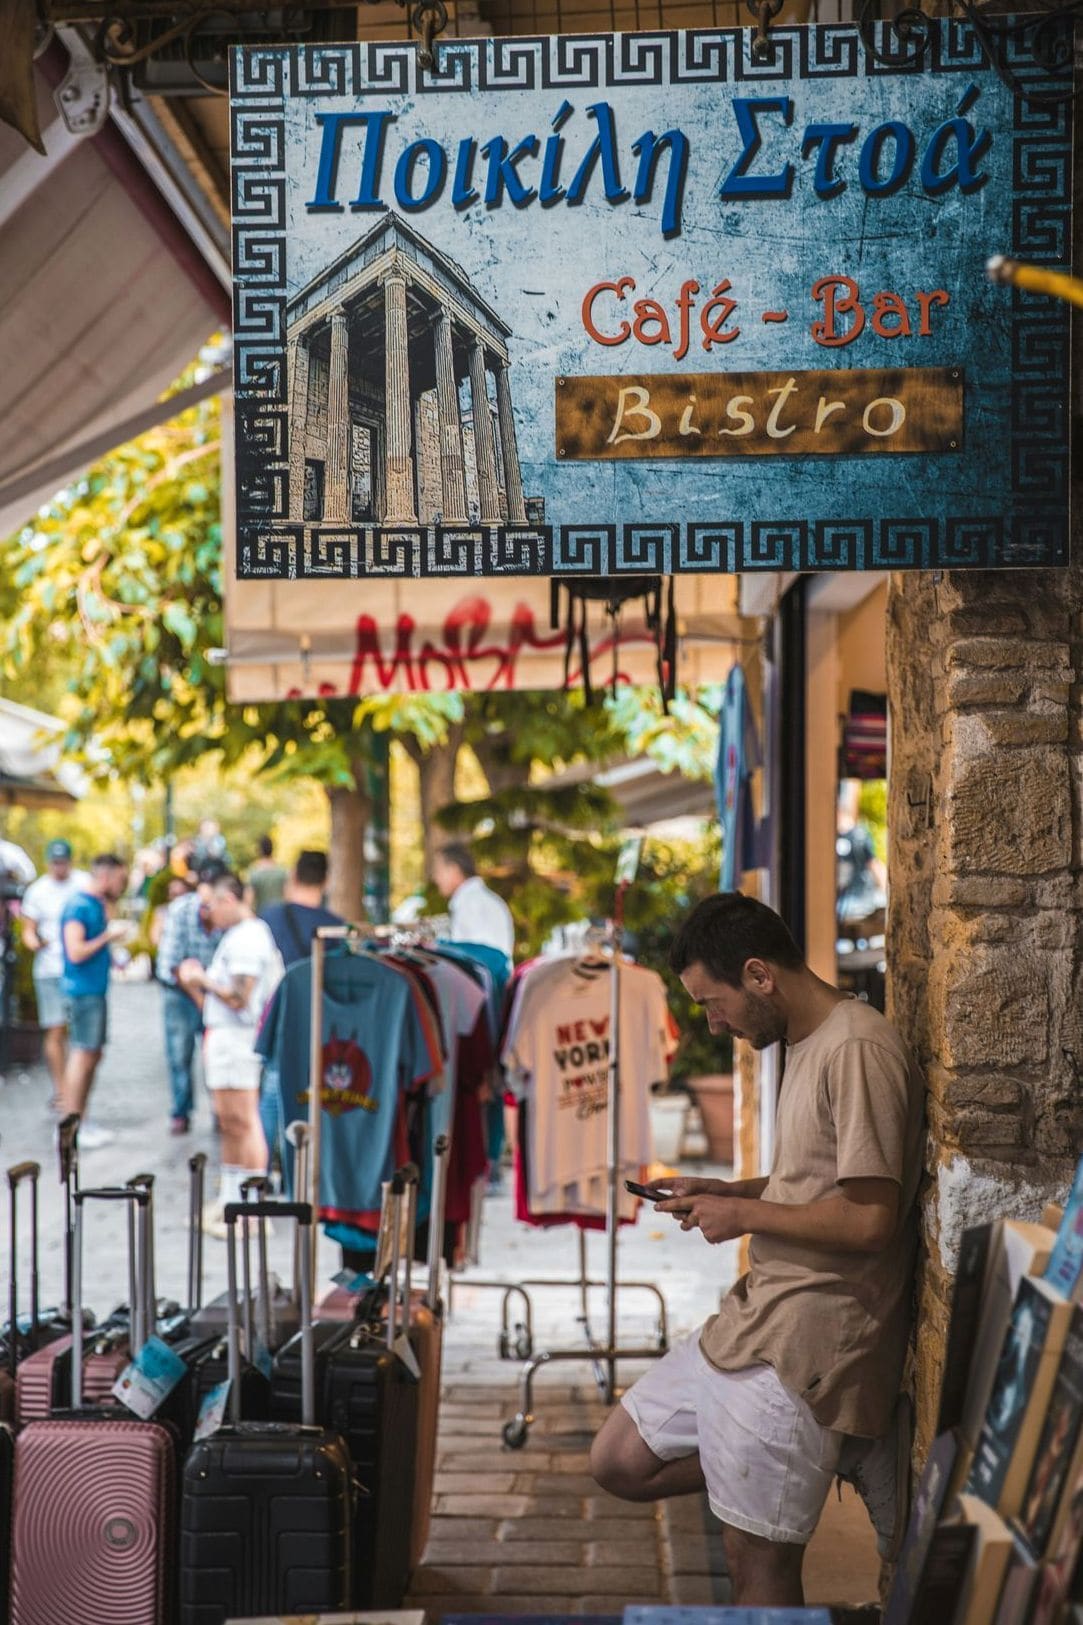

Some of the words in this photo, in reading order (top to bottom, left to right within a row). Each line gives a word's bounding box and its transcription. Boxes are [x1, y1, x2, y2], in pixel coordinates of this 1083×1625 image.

[305, 99, 686, 238] Ποικίλη
[719, 83, 991, 197] Στοά
[581, 276, 741, 361] Café
[810, 275, 950, 348] Bar
[607, 377, 906, 444] Bistro
